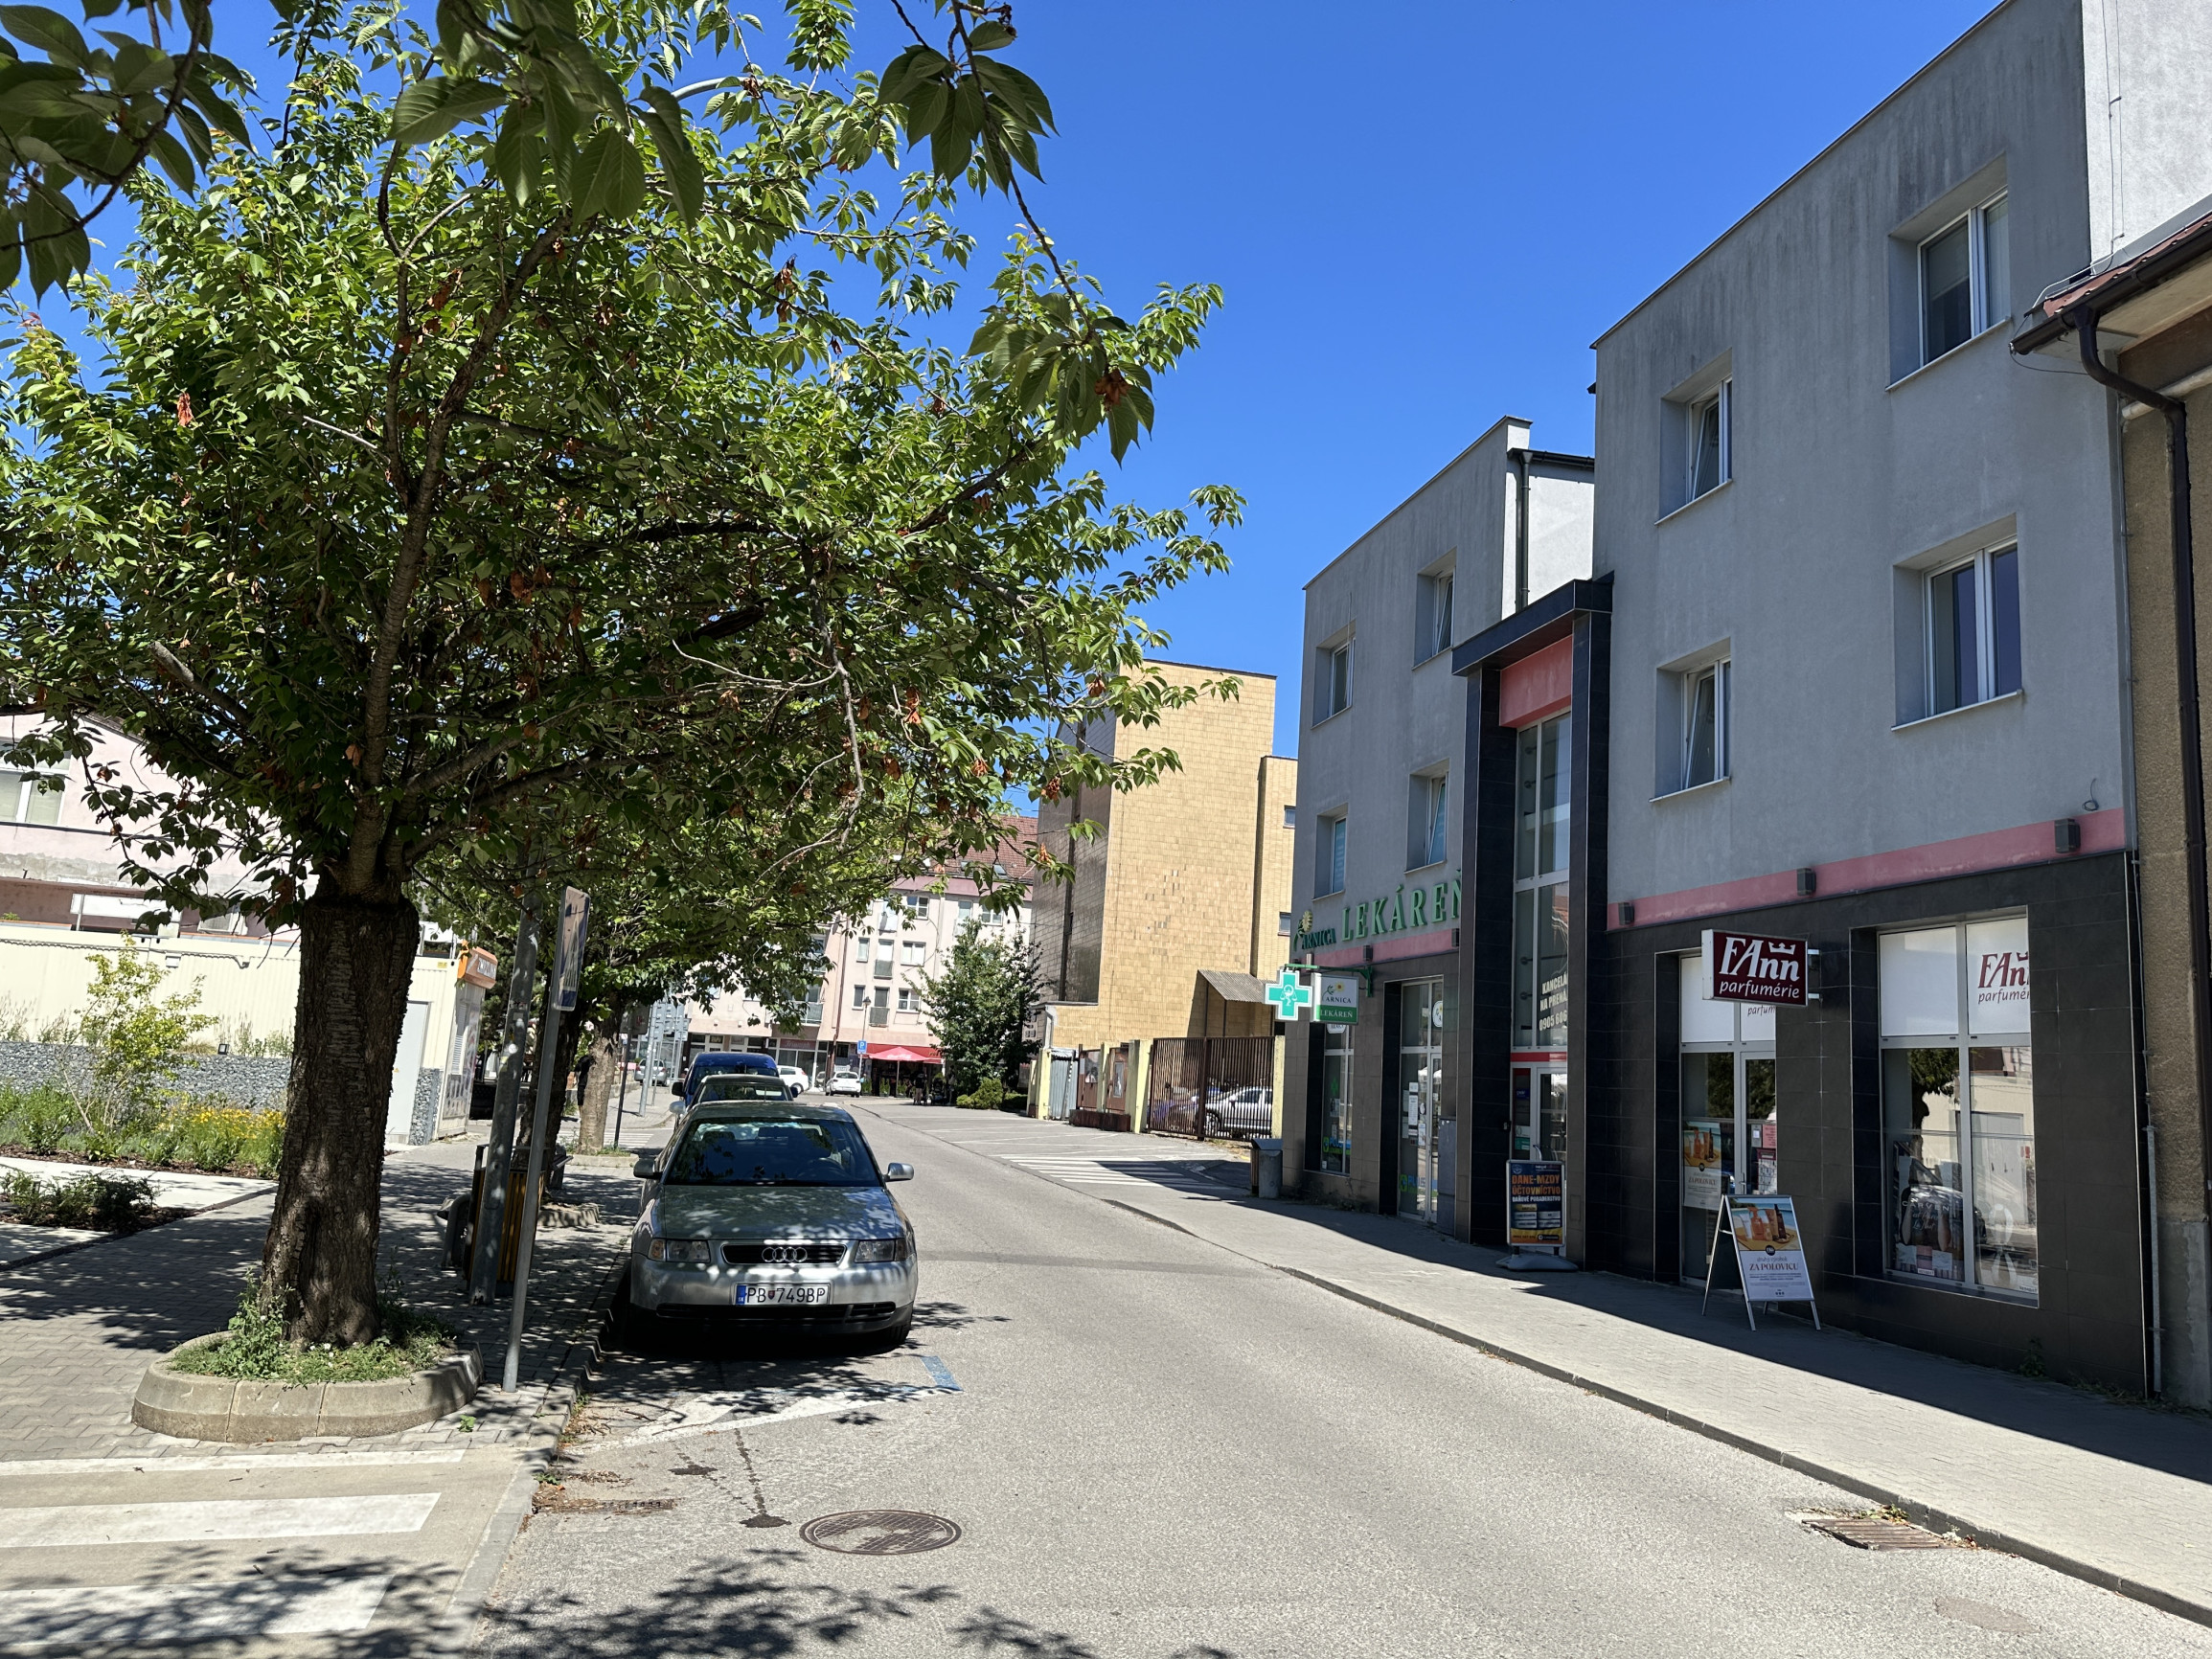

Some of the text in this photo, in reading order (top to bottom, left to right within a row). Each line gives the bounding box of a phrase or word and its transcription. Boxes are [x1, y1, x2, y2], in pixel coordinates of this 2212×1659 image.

[1301, 928, 1336, 949] ARNICA
[1719, 937, 1800, 982] FAnn
[1977, 952, 2029, 989] FAn
[1720, 980, 1800, 998] parfumérie
[1320, 1009, 1353, 1018] LEKÁREŇ
[1539, 1010, 1567, 1032] 0905 606
[1902, 1200, 1950, 1212] CARVEN
[1761, 1262, 1798, 1271] POLOVICU
[746, 1287, 766, 1303] PB
[776, 1287, 826, 1303] 749BP
